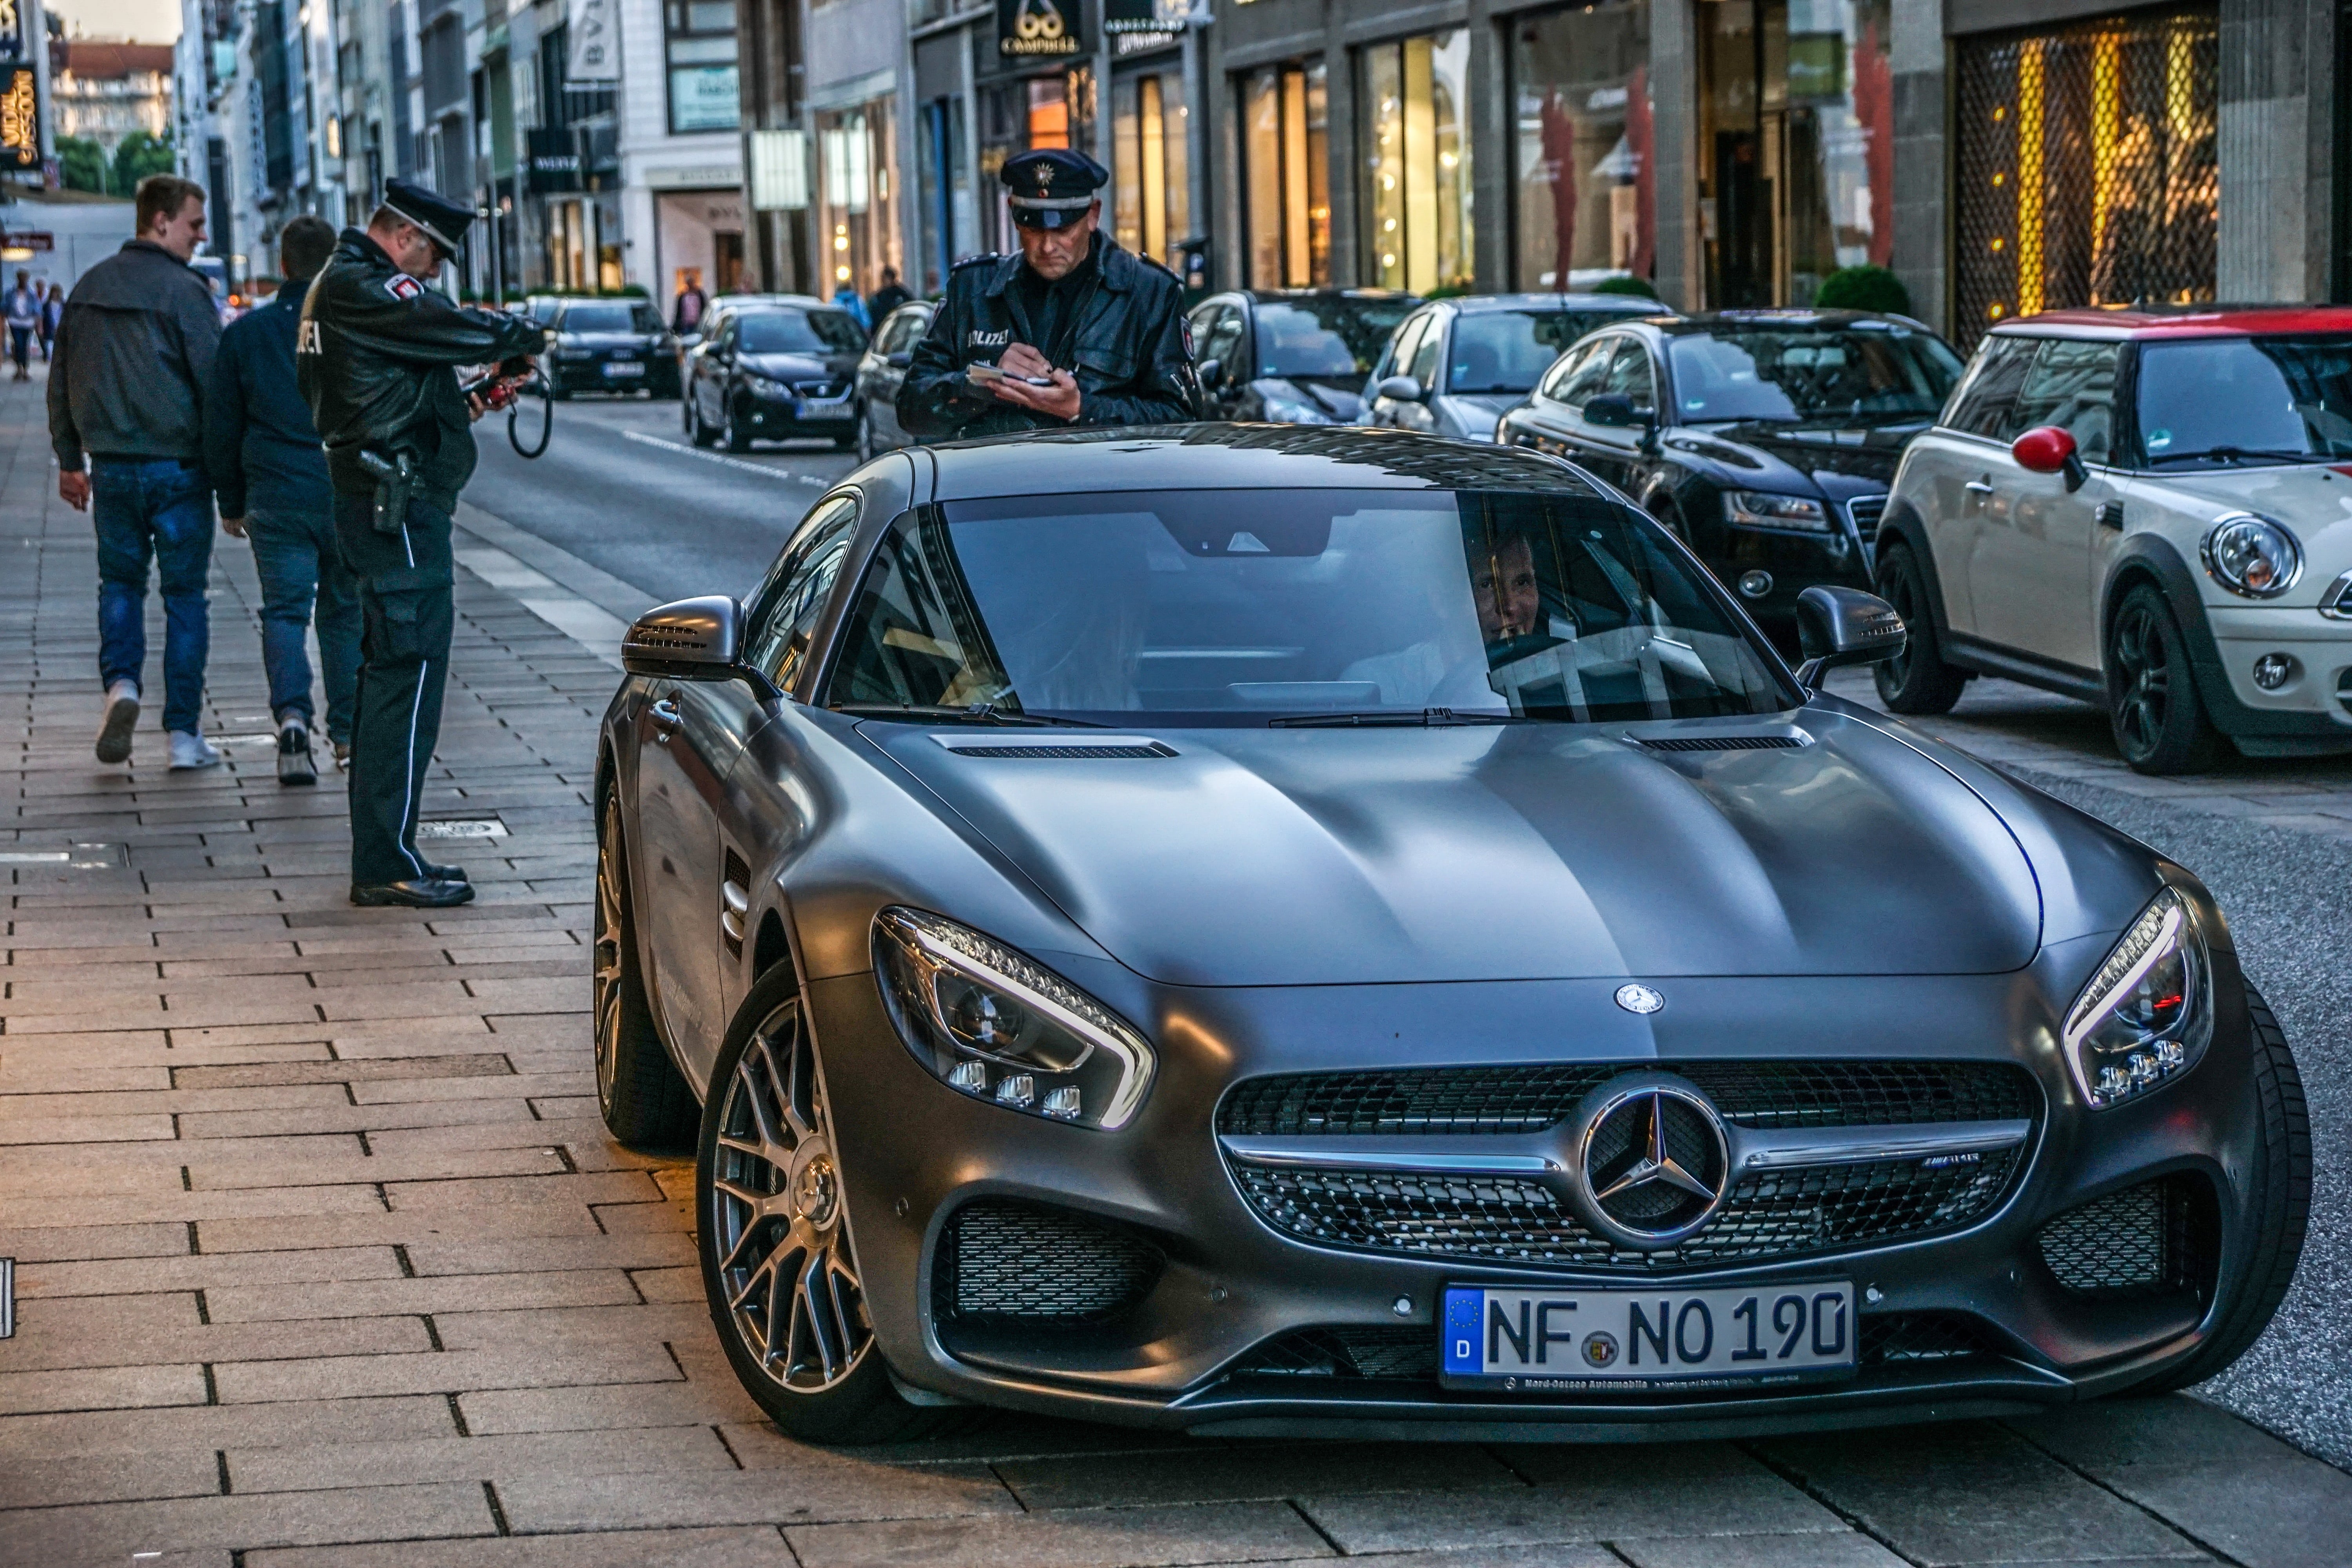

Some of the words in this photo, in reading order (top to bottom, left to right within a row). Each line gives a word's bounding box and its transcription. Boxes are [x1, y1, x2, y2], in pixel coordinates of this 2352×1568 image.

[1457, 1339, 1470, 1358] D
[1489, 1299, 1577, 1363] NF
[1628, 1298, 1713, 1364] NO
[1731, 1292, 1846, 1361] 190
